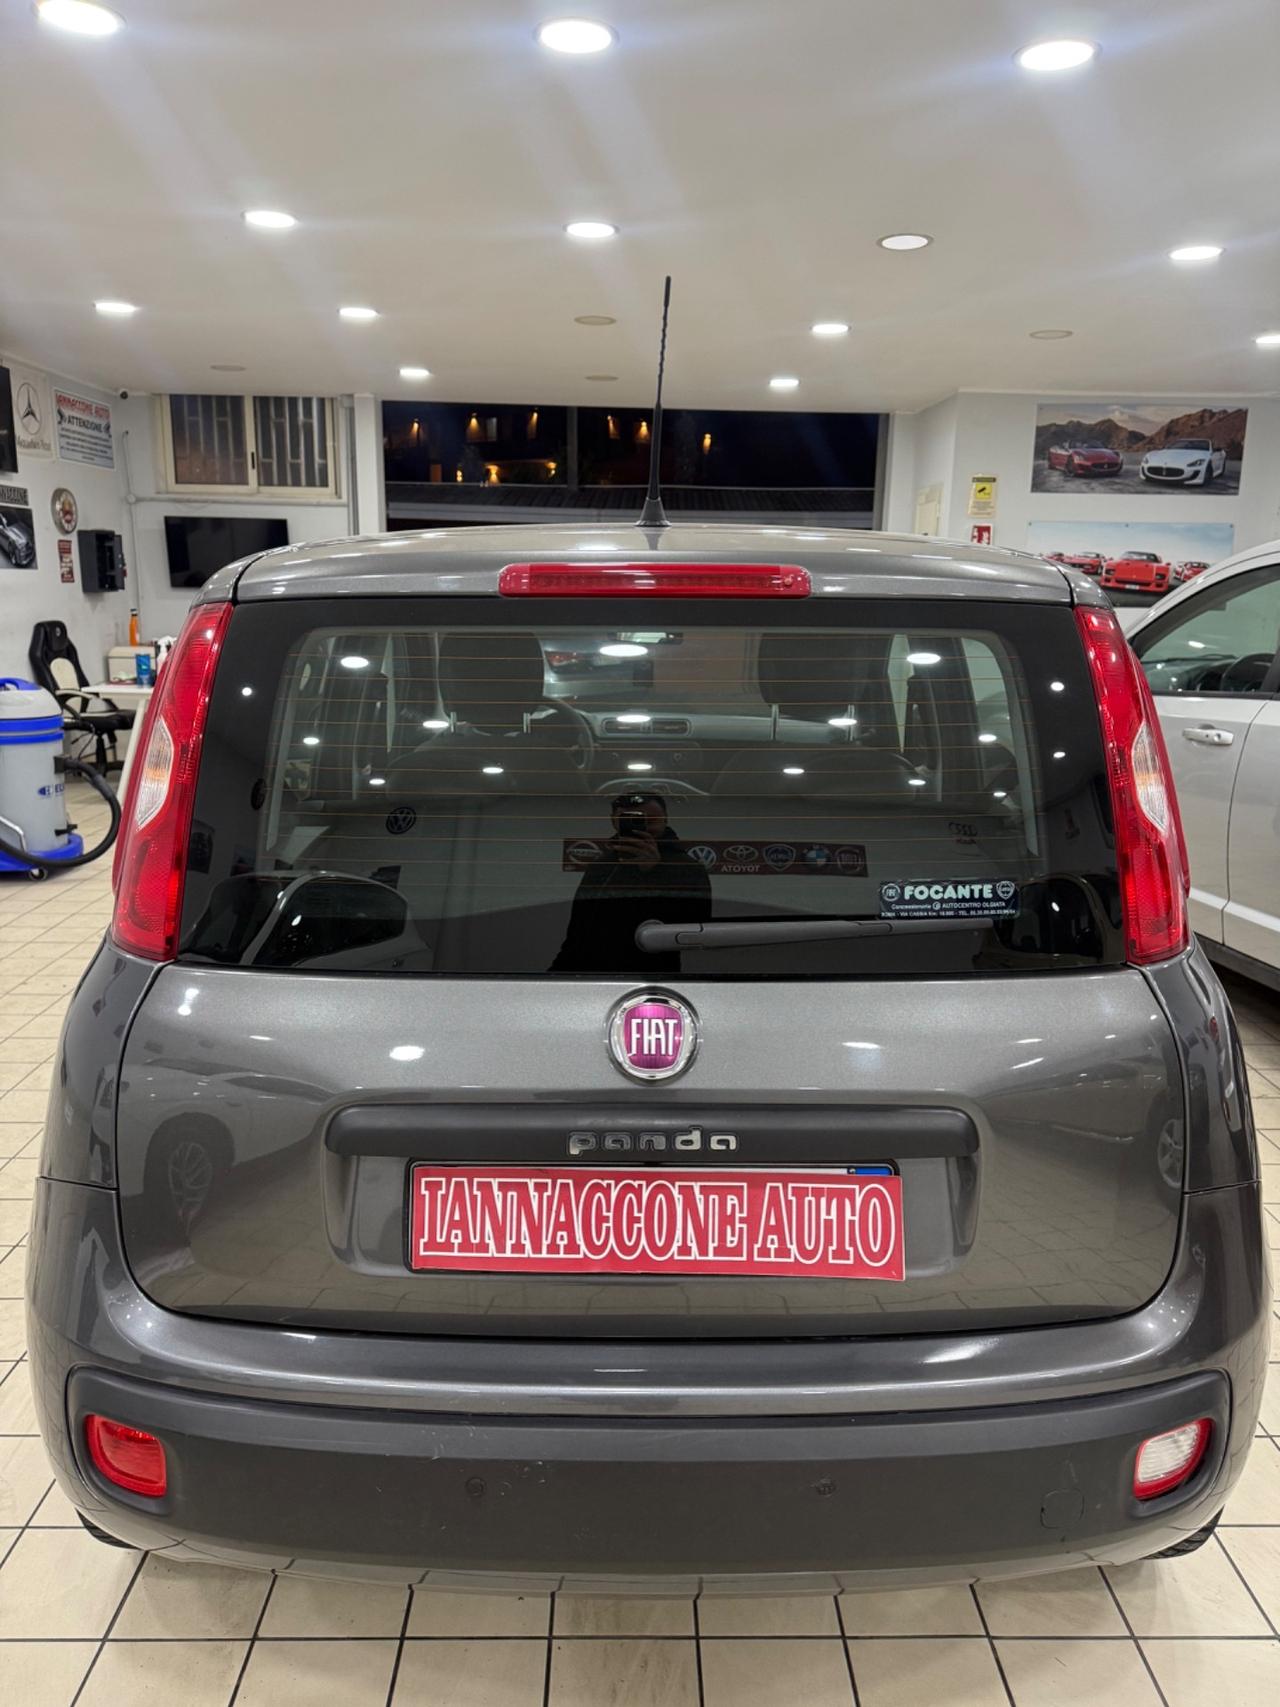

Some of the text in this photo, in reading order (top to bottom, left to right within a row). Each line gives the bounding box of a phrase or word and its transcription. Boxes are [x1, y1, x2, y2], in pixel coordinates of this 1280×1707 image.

[67, 415, 102, 433] ATTENZIONE
[904, 884, 993, 900] FOCANTE
[628, 1018, 679, 1057] FIAT
[567, 1126, 740, 1157] panda
[419, 1177, 897, 1267] IANNACCONE AUTO
